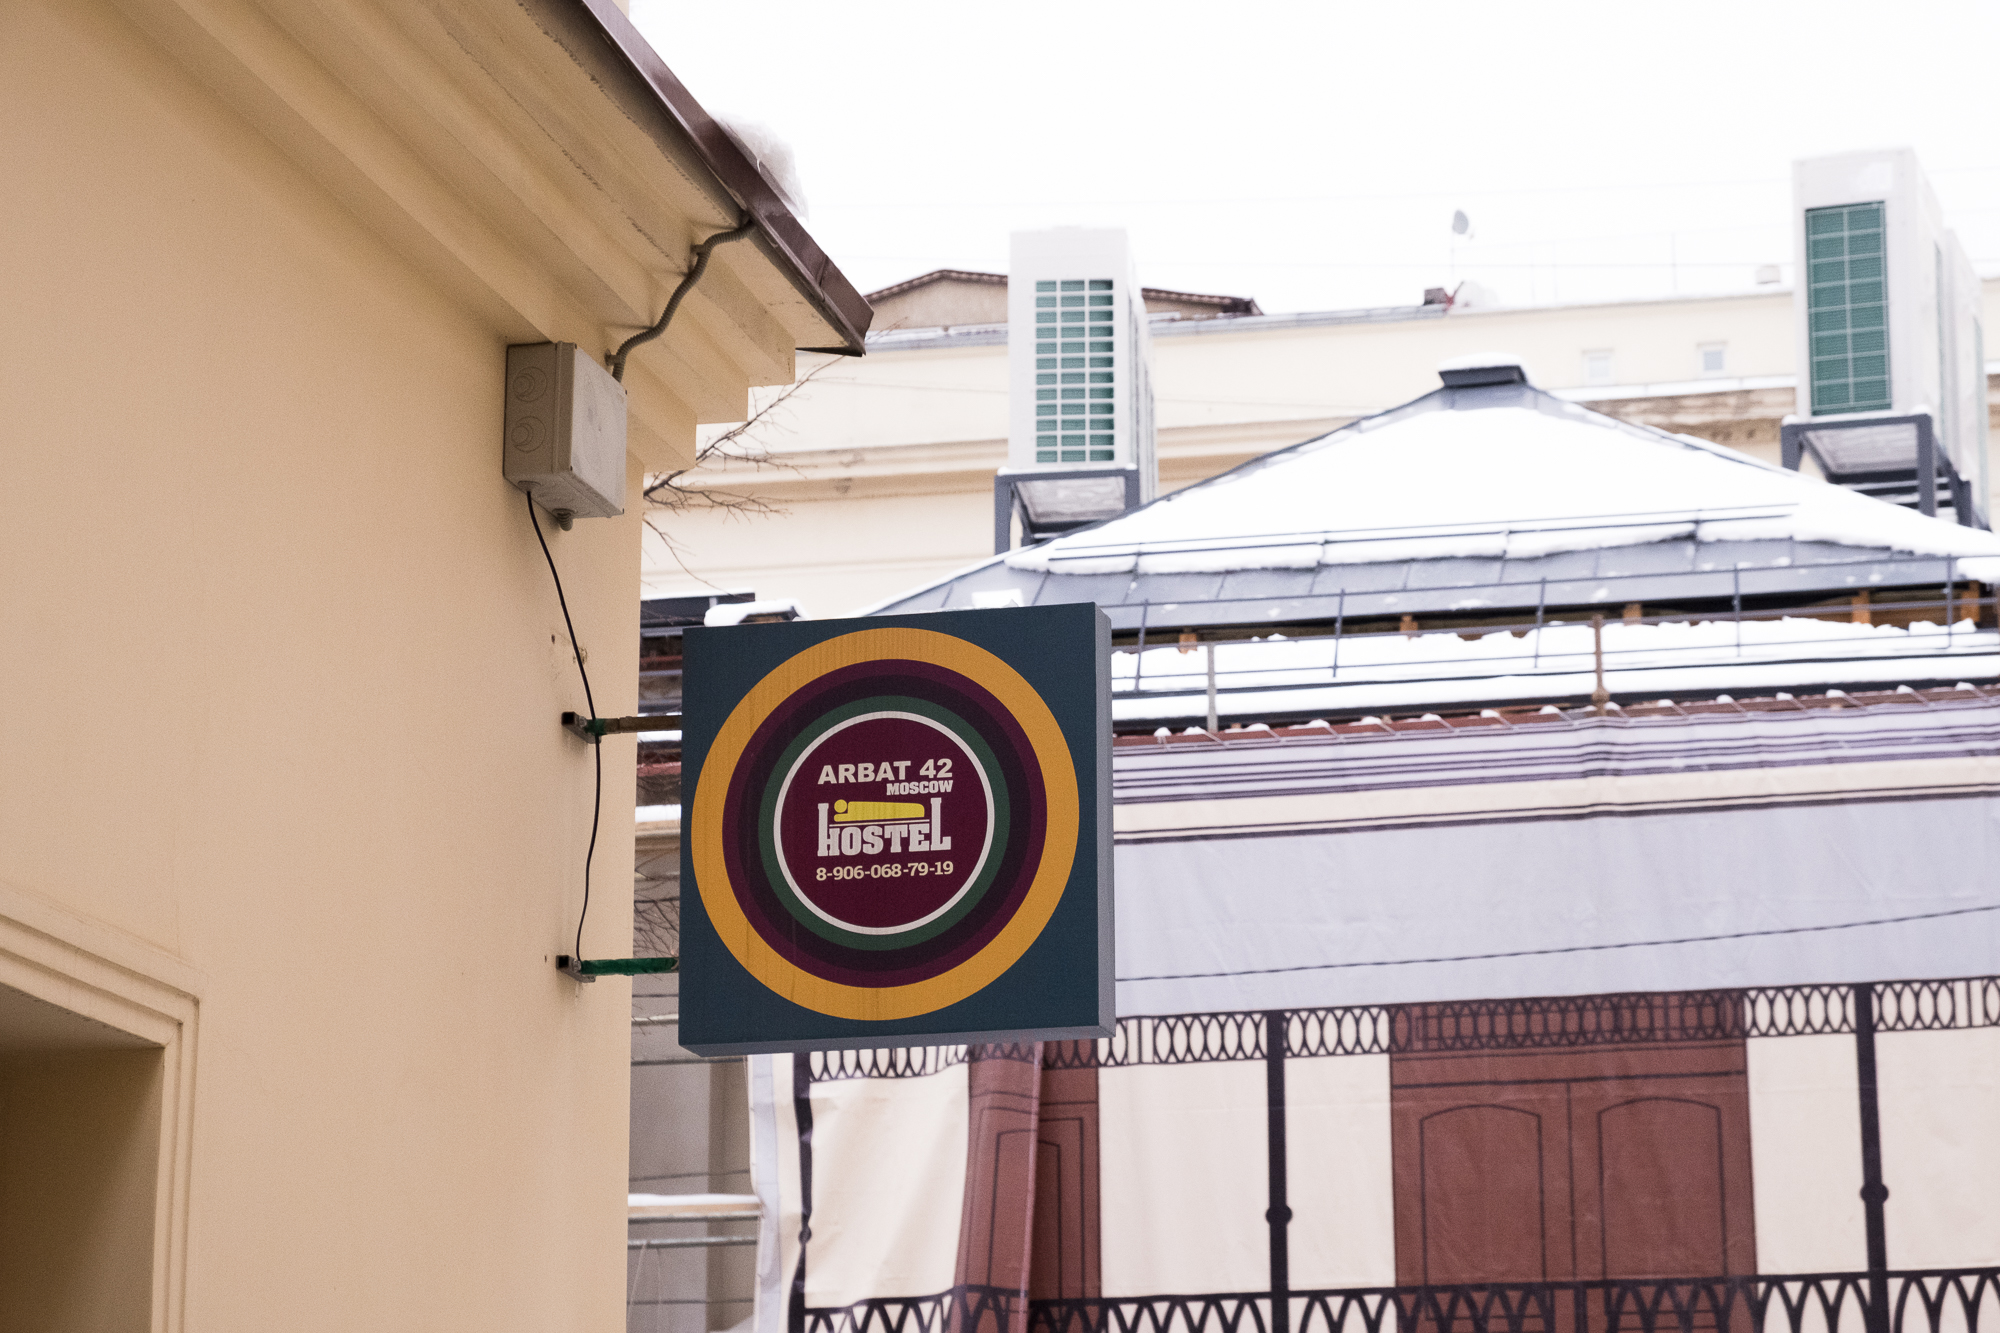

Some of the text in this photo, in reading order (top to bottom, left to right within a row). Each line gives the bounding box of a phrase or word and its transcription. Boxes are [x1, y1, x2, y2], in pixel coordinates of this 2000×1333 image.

[817, 758, 953, 785] ARBAT 42
[886, 780, 954, 796] MOSCOW
[816, 860, 954, 881] 8-906-068-79-19
